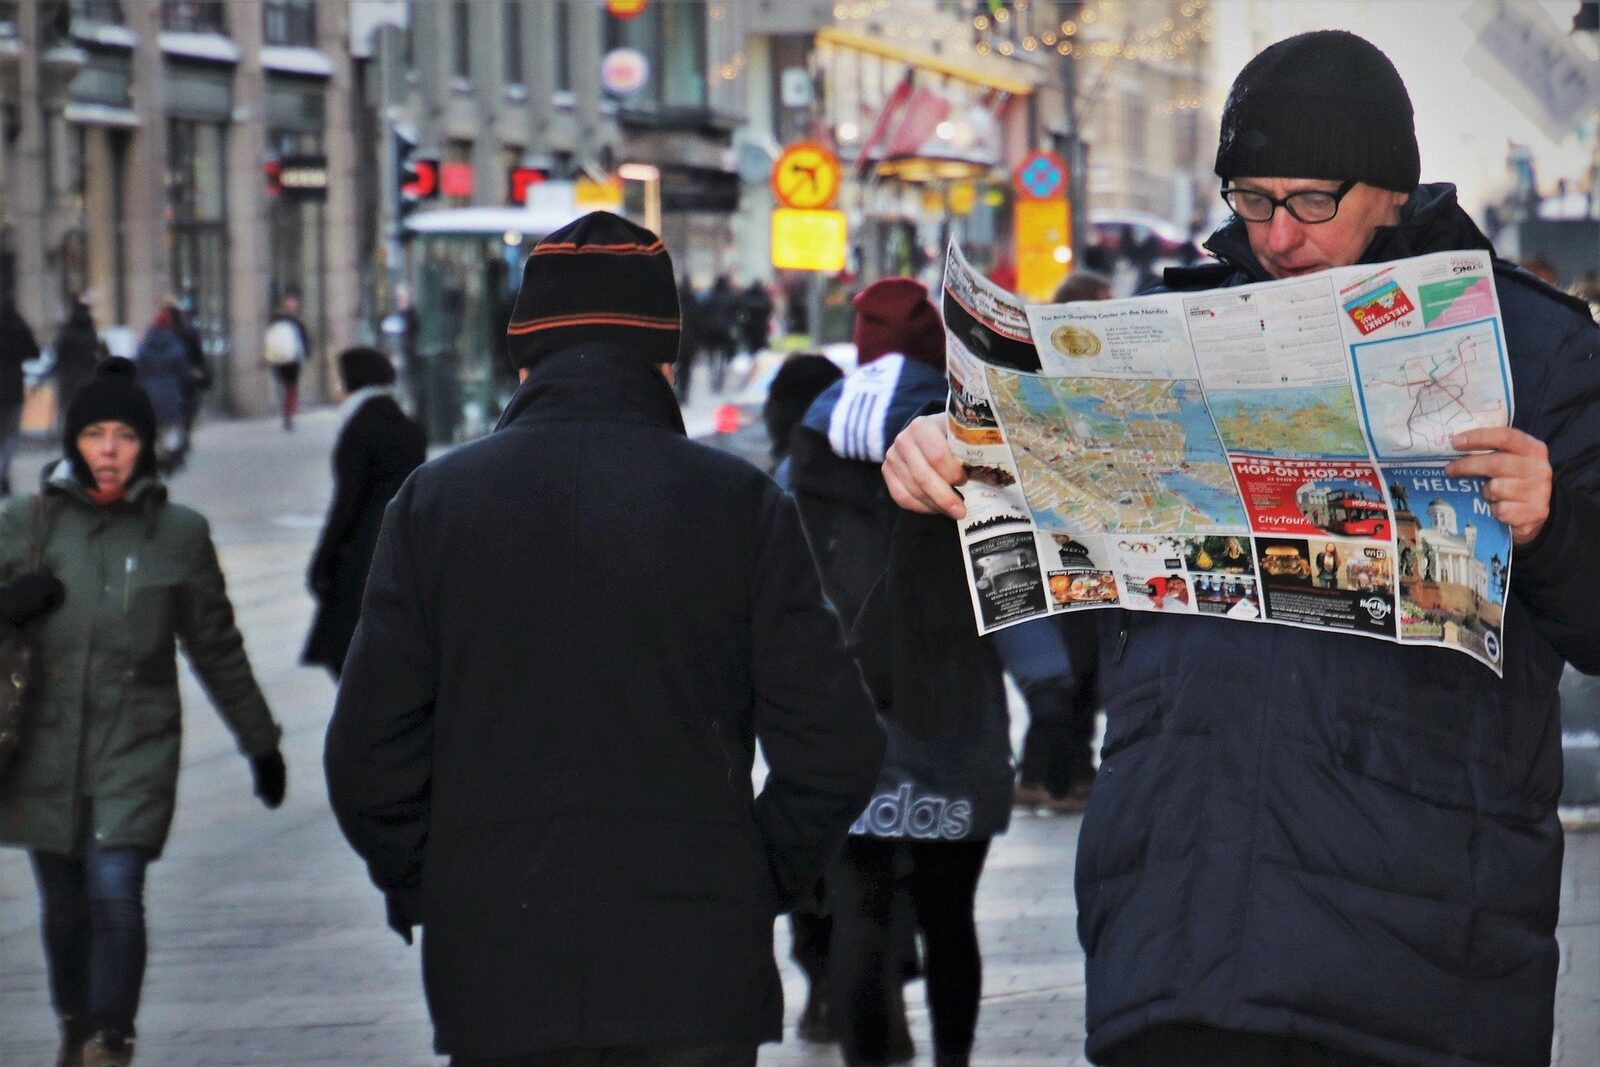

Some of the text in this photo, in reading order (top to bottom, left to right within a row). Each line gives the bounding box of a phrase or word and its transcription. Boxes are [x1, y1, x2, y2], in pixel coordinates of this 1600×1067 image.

[1364, 304, 1409, 332] HELSINKI
[1237, 465, 1373, 478] HOP-ON HOP-OFF
[1413, 478, 1485, 493] HELSI
